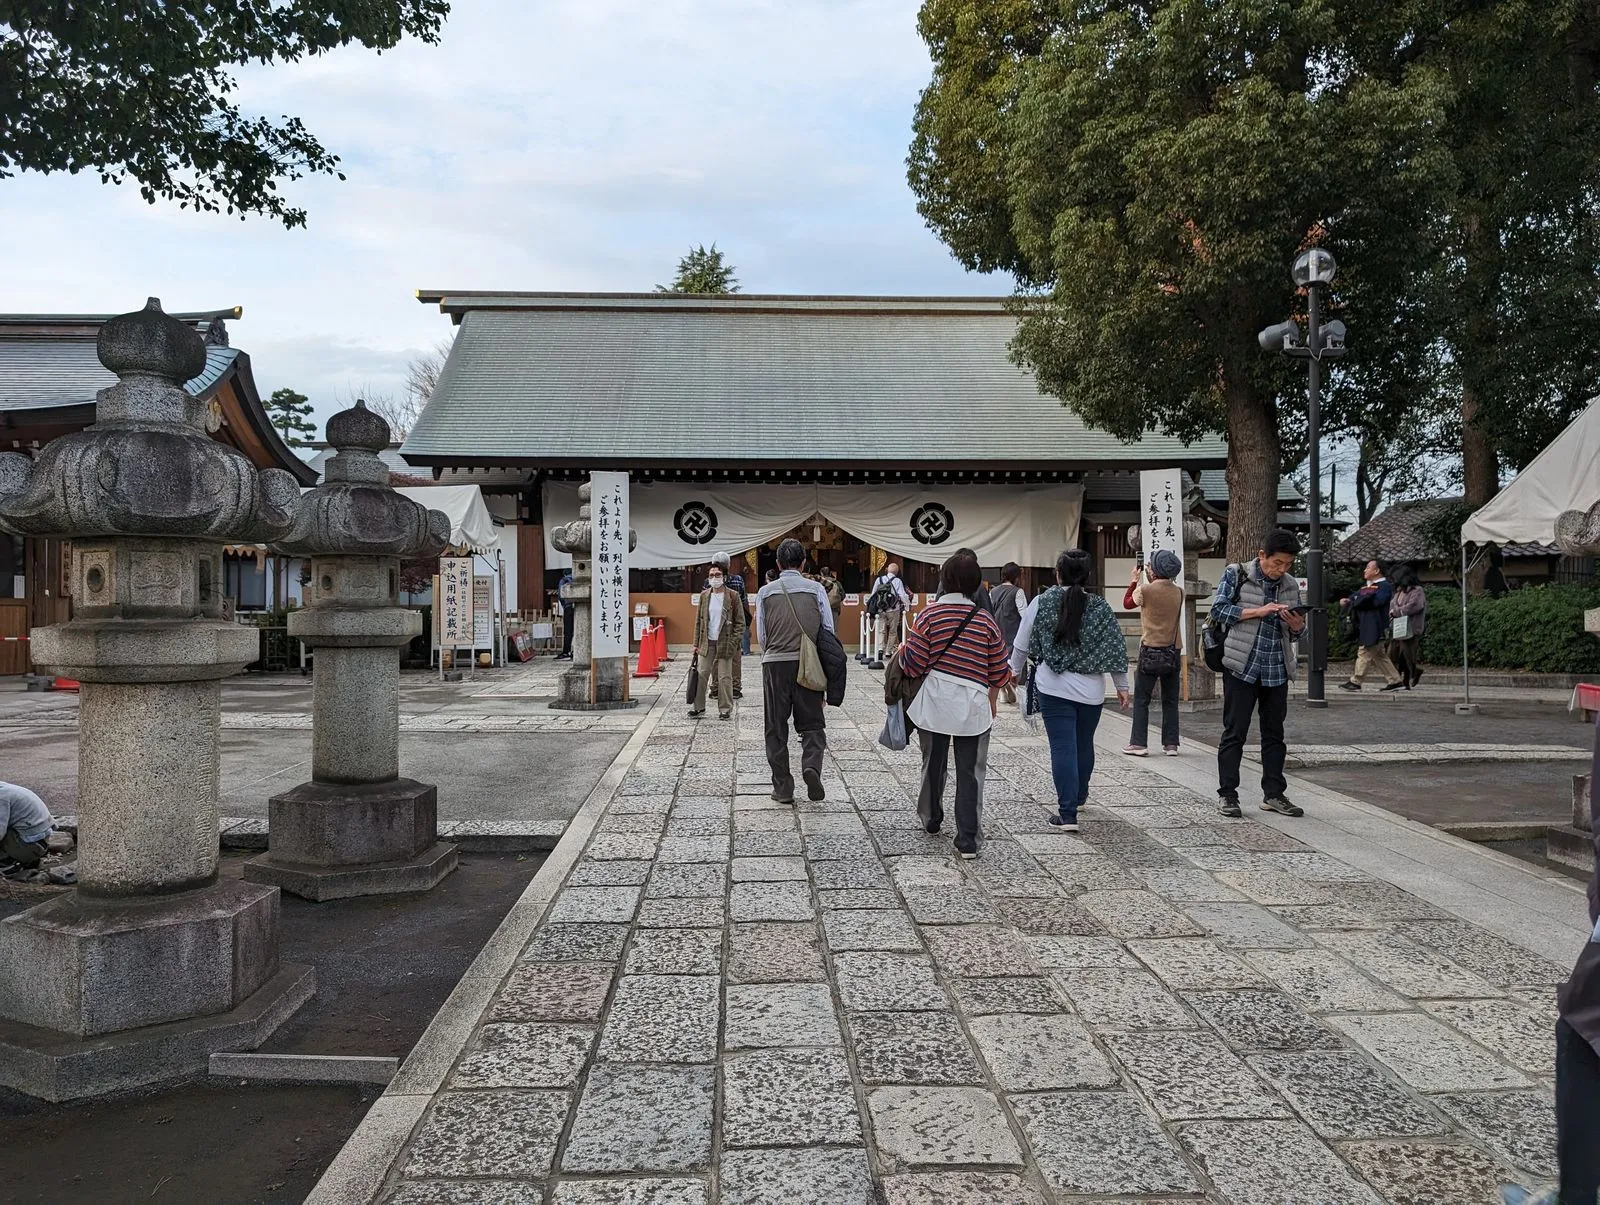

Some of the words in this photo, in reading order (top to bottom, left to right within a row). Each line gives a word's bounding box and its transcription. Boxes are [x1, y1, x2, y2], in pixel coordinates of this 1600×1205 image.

[1148, 493, 1161, 556] ご参拝をお
[1164, 481, 1176, 555] これより先、
[446, 560, 458, 640] 申込用紙記載所
[598, 494, 611, 638] ご参拝をお願いいたします。
[612, 484, 624, 644] これより先、列を横にひろげて
